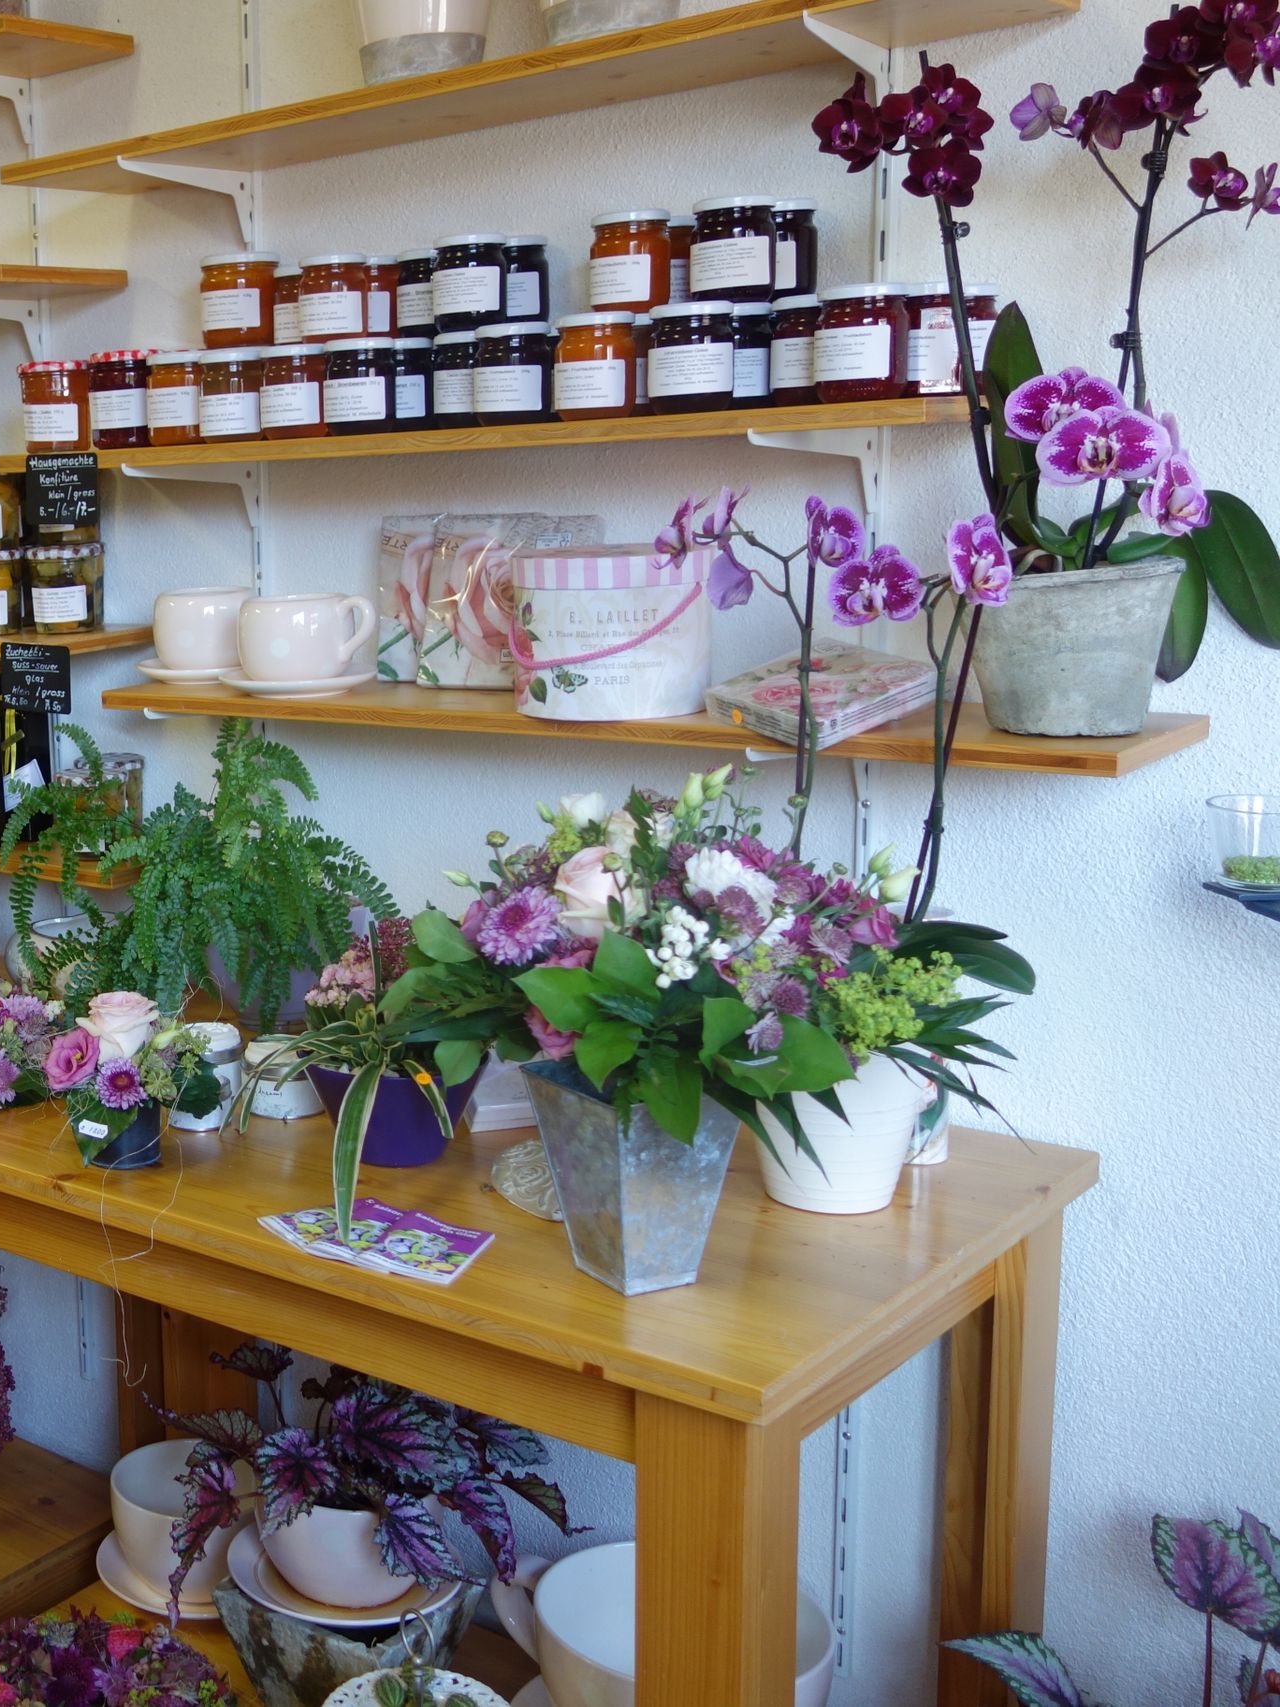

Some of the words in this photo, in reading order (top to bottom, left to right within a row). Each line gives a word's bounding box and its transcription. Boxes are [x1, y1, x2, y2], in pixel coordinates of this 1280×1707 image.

[40, 470, 79, 487] Konfitüre
[596, 608, 659, 624] LAILLET
[594, 675, 631, 685] PARIS
